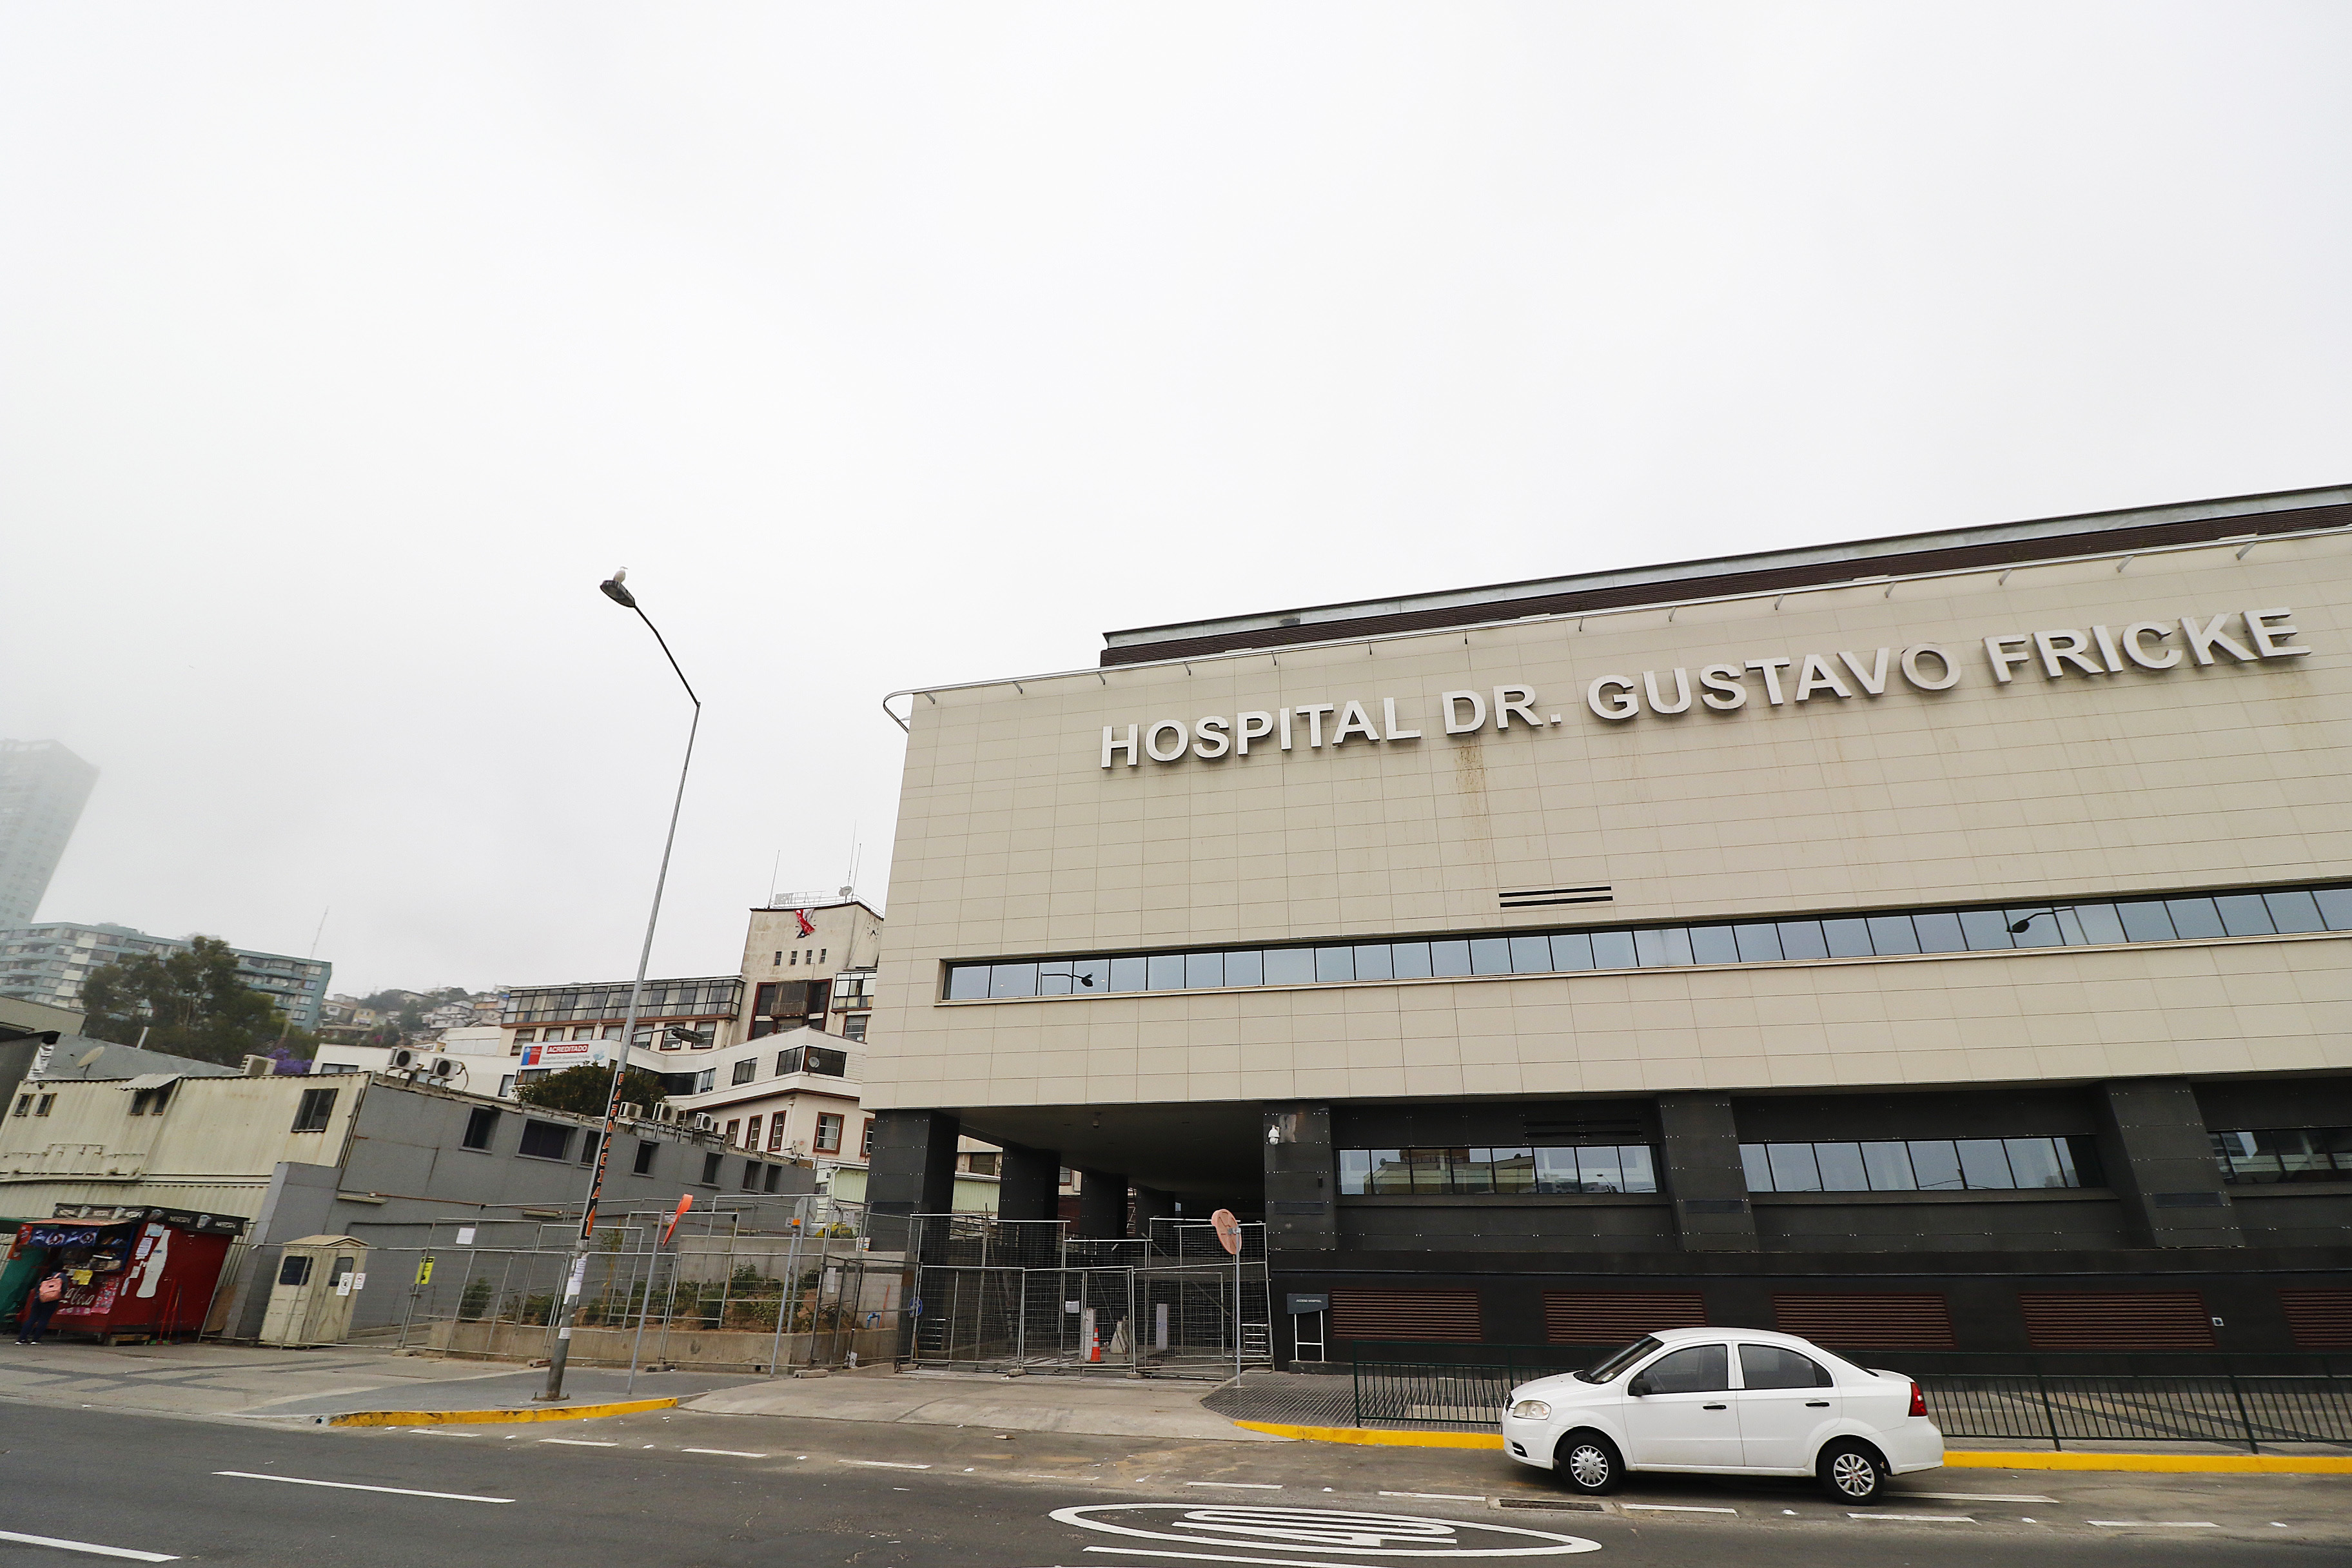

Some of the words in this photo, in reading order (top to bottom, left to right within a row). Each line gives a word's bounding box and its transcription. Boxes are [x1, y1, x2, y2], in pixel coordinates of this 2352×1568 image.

[1101, 697, 1421, 769] HOSPITAL
[1442, 683, 1561, 735] DR.
[1587, 642, 1963, 721] GUSTAVO
[1984, 606, 2313, 683] FRICKE
[591, 1073, 625, 1199] FARMACIA
